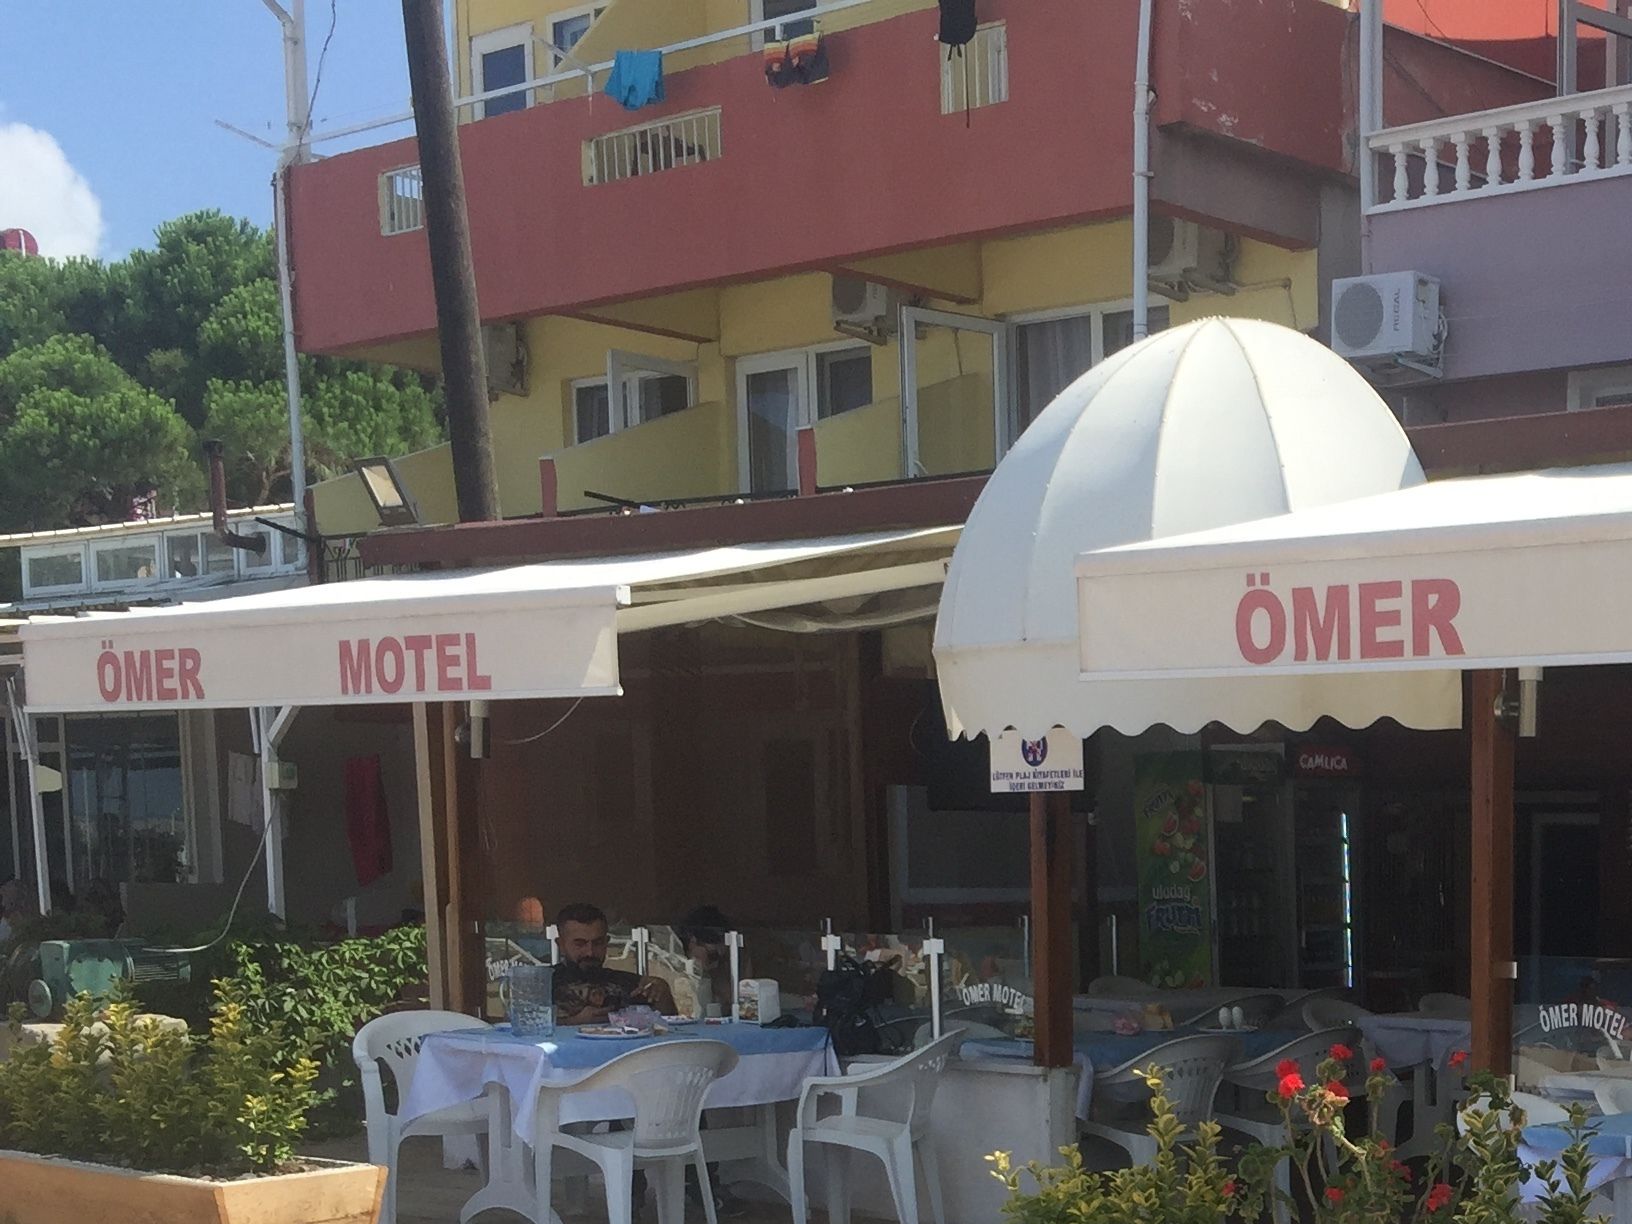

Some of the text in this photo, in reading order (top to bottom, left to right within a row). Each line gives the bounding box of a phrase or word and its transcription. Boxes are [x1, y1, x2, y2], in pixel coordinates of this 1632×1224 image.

[1235, 572, 1466, 665] ÖMER
[96, 632, 492, 703] ÖMER MOTEL
[1016, 770, 1031, 780] PLAJ
[992, 983, 1025, 1013] MOTEL
[1538, 1003, 1626, 1040] ÖMER MOTEL
